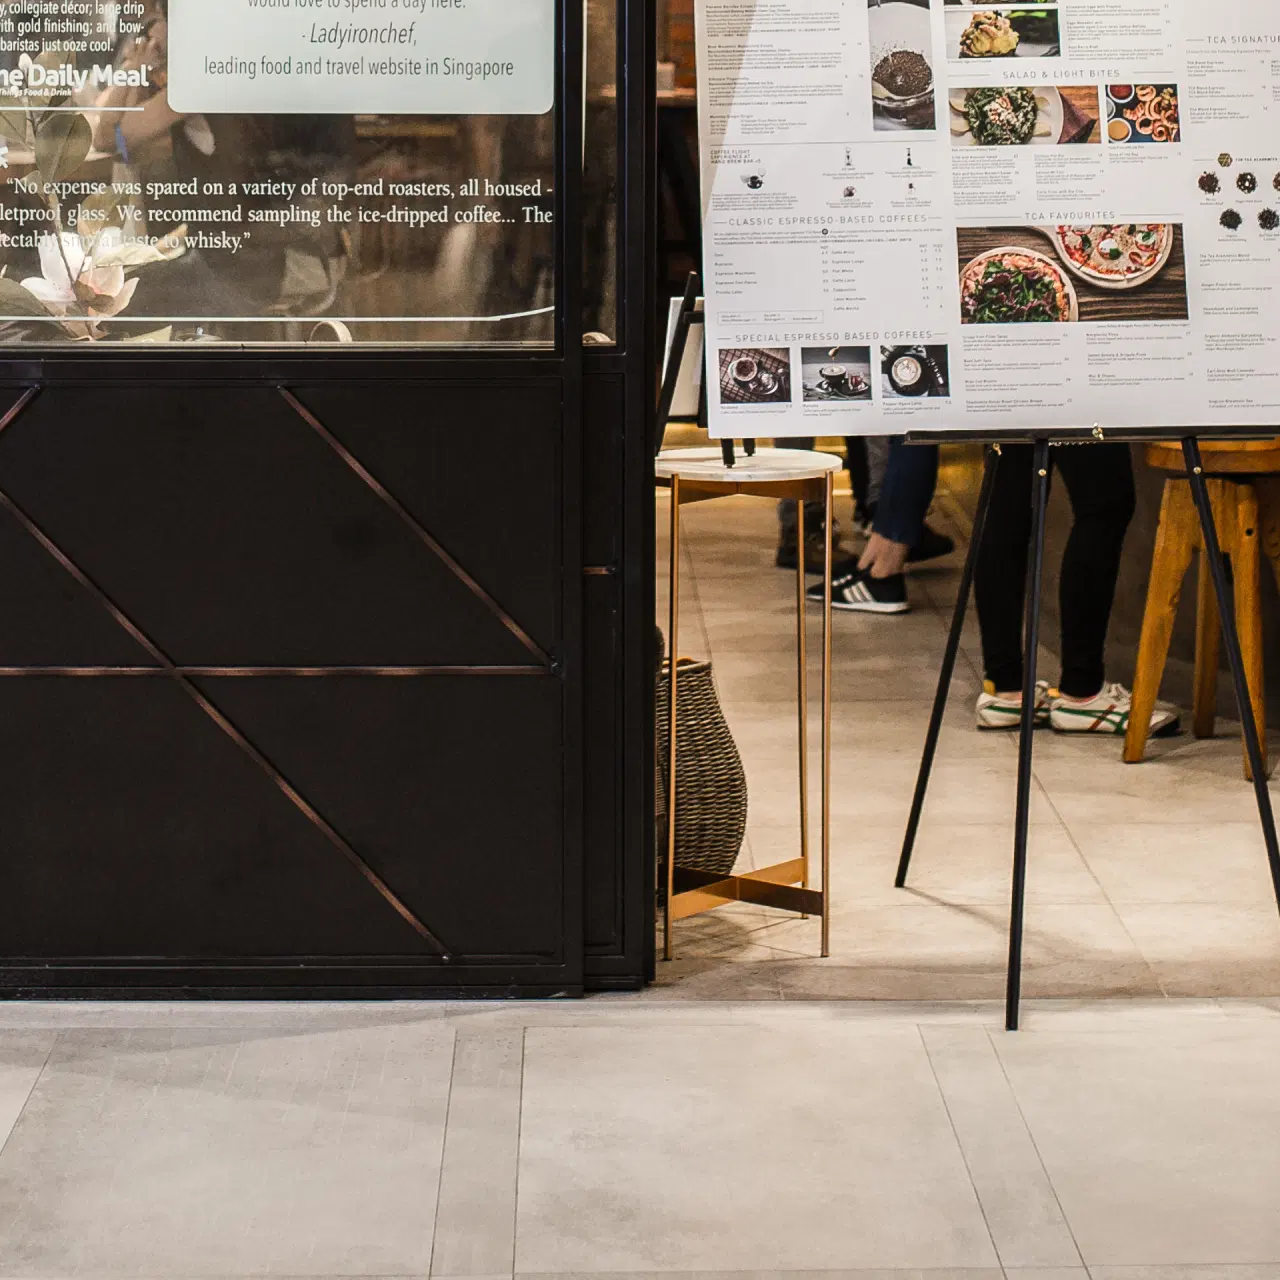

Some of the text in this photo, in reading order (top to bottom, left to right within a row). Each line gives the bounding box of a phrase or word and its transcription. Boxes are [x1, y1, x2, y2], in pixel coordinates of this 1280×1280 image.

[310, 22, 417, 49] Ladyironchef,
[205, 57, 514, 80] leading food and travel website in Singapore
[1003, 70, 1037, 79] SALAD
[1053, 70, 1084, 78] LIGHT
[1090, 69, 1120, 78] BITES
[28, 65, 85, 92] Daily
[90, 65, 149, 86] Meal
[729, 217, 774, 226] CLASSIC
[880, 215, 927, 223] COFFEES
[1050, 211, 1115, 220] FAVOURITES
[736, 330, 932, 342] SPECIAL ESPRESSO BASED COFFEES
